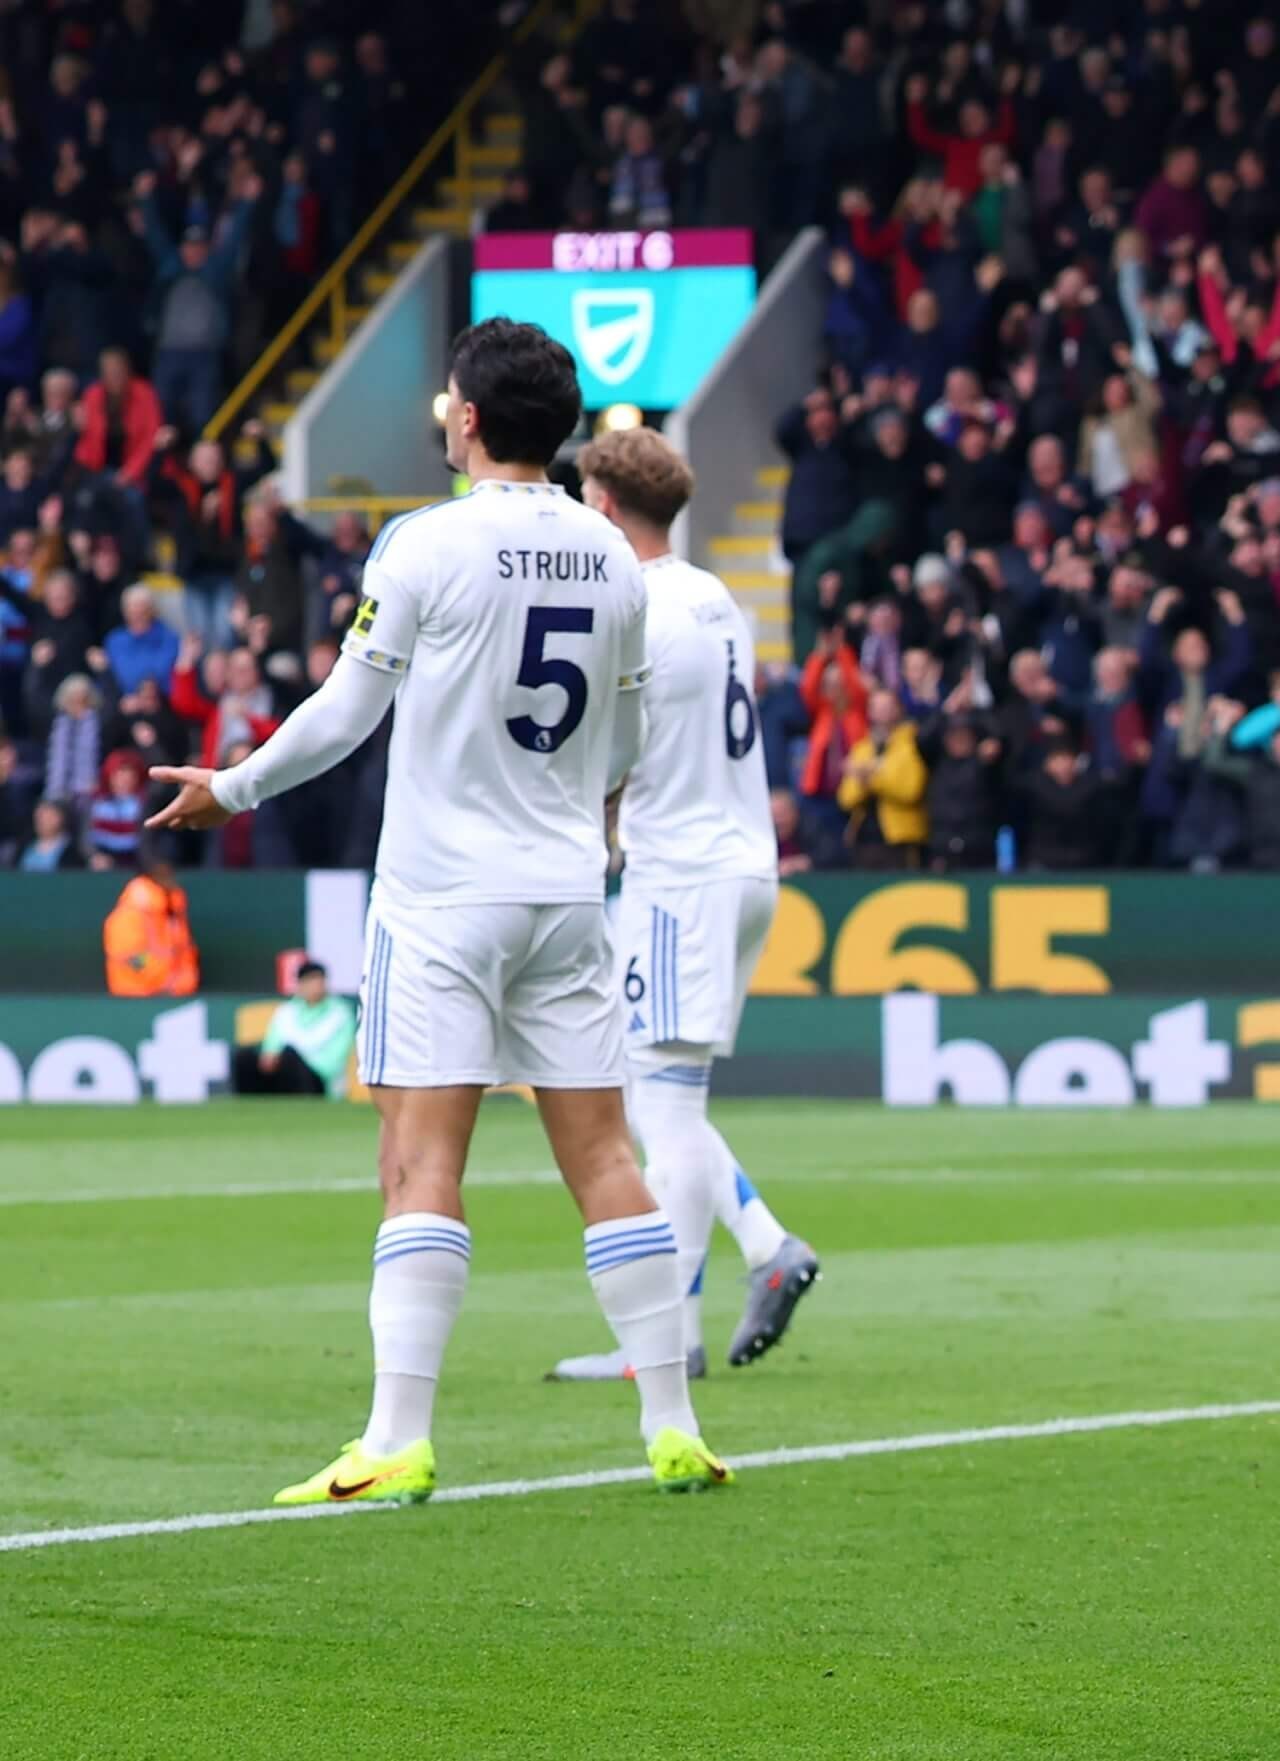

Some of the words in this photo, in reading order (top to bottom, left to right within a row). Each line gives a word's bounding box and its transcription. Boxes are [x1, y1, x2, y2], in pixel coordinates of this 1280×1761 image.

[552, 232, 641, 272] EXIT
[497, 550, 608, 583] STRUIJK
[505, 606, 594, 754] 5
[725, 638, 755, 760] 6
[625, 955, 645, 1004] 6
